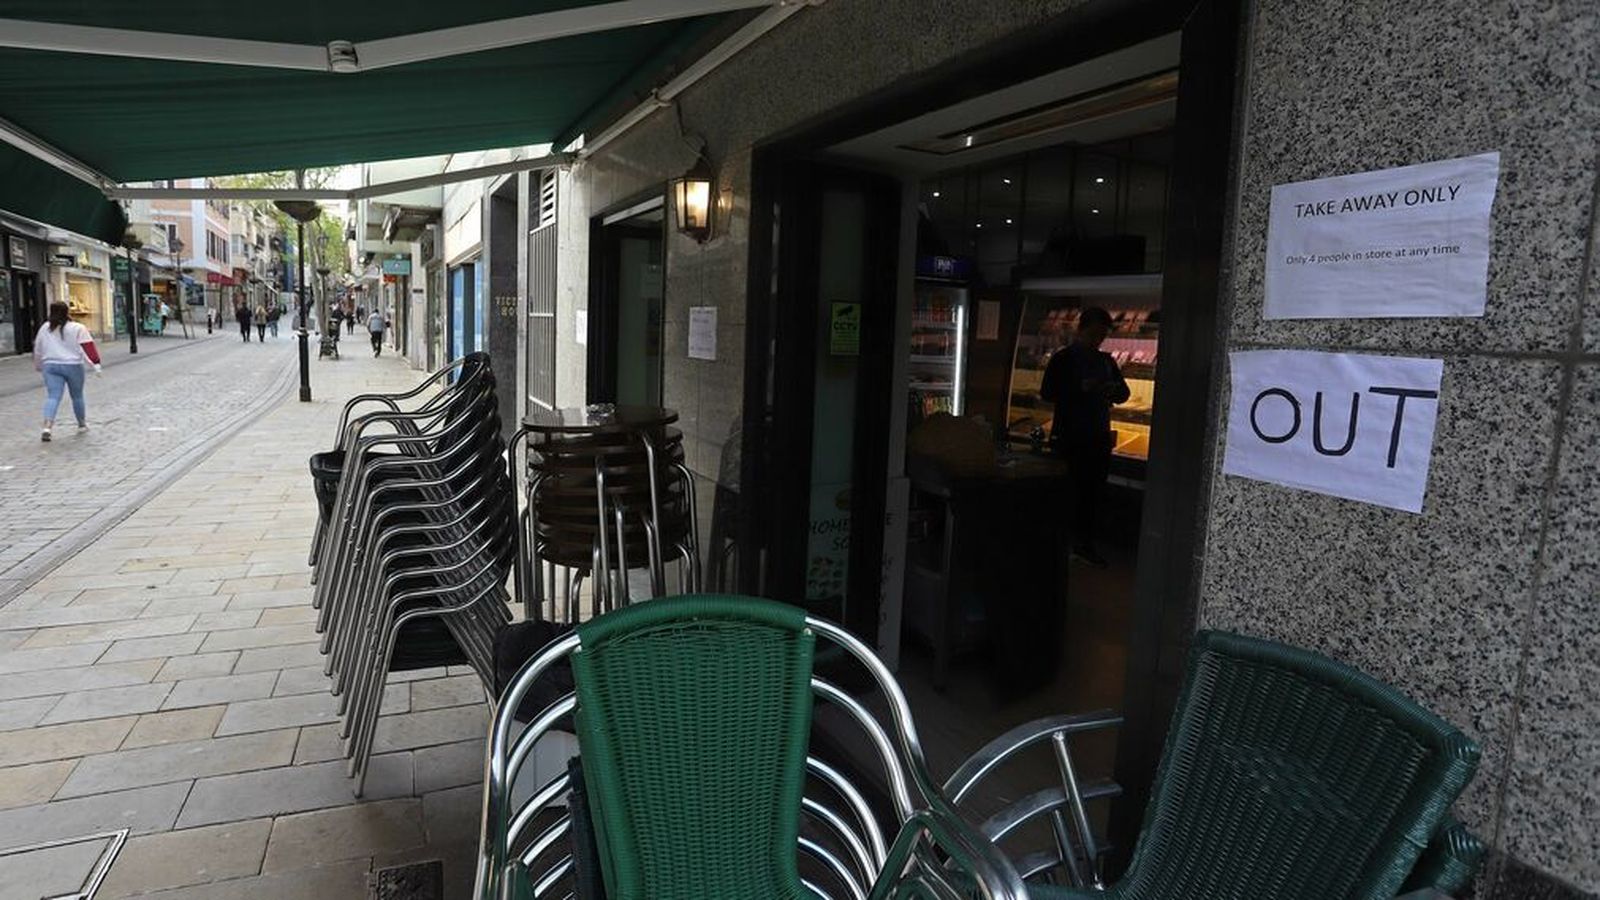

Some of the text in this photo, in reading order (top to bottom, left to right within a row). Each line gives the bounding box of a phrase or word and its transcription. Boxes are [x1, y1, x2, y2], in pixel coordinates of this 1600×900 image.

[1295, 184, 1462, 219] TAKE AWAY ONLY
[1286, 244, 1461, 265] Only 4 people in store at any time
[1250, 386, 1439, 470] OUT
